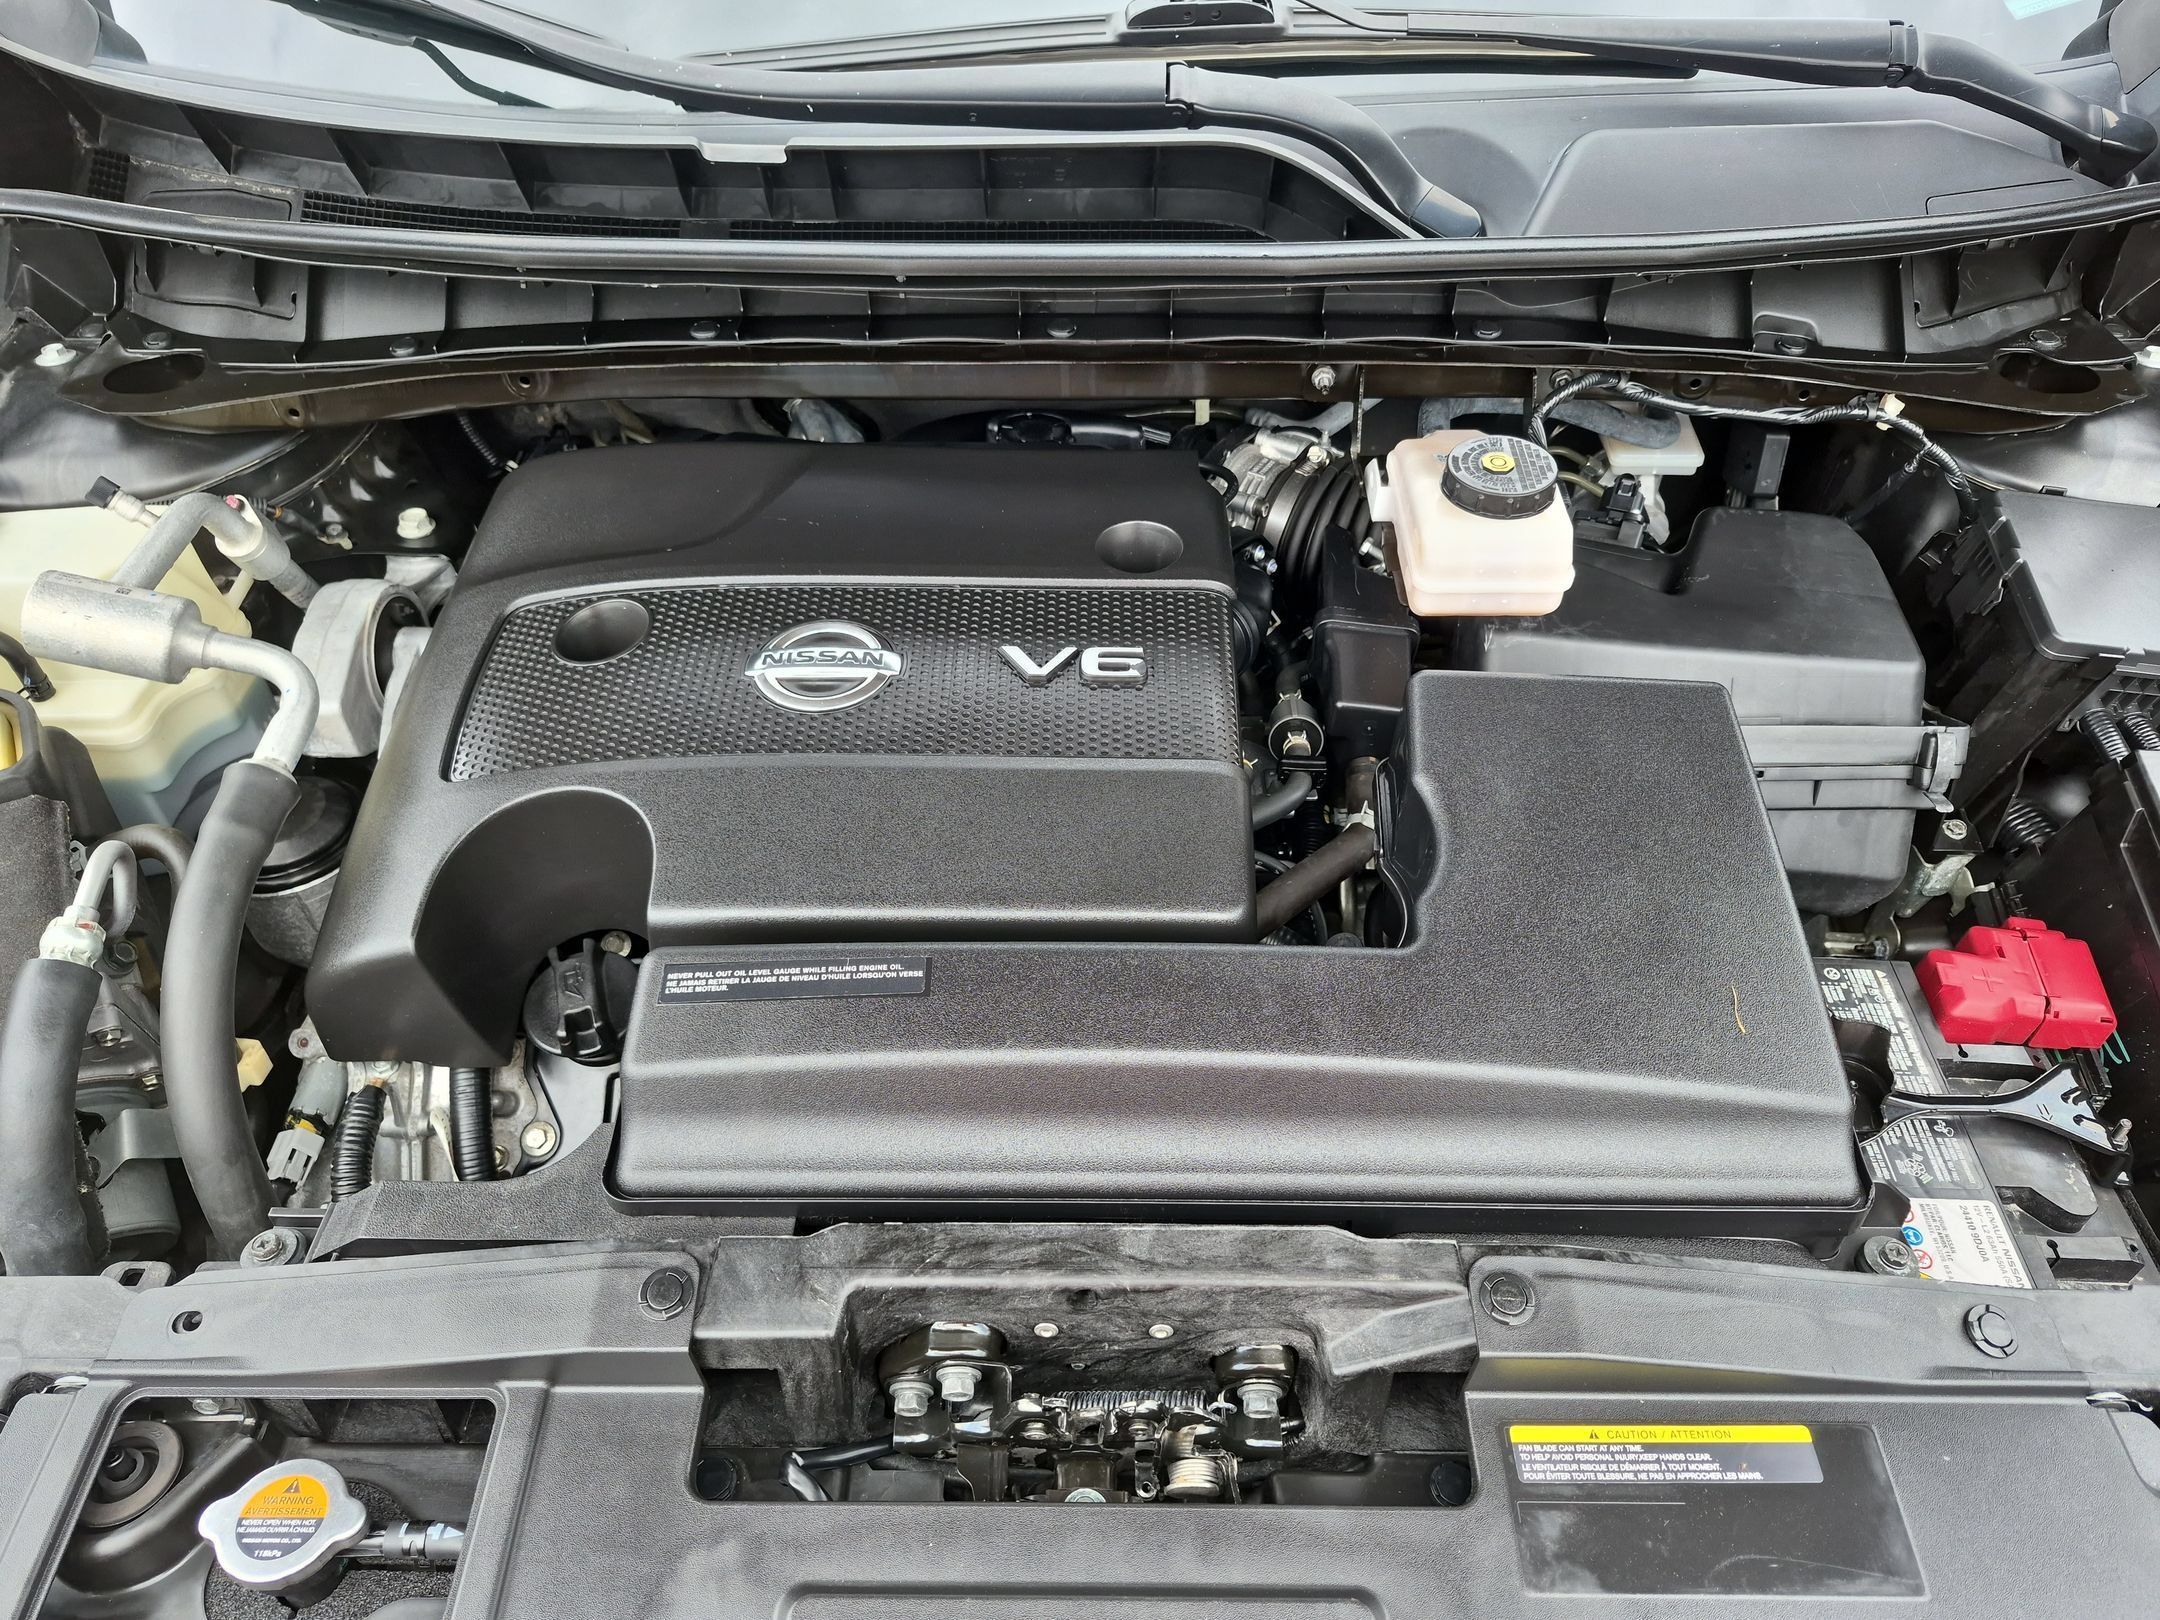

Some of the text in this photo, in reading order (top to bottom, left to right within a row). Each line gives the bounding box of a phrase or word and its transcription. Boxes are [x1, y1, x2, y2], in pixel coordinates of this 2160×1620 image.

[760, 648, 885, 666] NISSAN
[998, 645, 1148, 687] V6
[667, 972, 693, 980] NEVER
[694, 971, 714, 979] PULL
[715, 970, 732, 978] OUT
[734, 969, 747, 977] OIL
[748, 968, 771, 976] LEVEL
[773, 967, 801, 975] GAUGE
[802, 966, 826, 974] WHILE
[828, 965, 857, 973] FILLING
[678, 979, 706, 987] JAMAIS
[752, 976, 777, 984] JAUGE
[791, 974, 819, 982] NIVEAU
[853, 971, 897, 979] LORSQU'ON
[695, 985, 729, 993] MOTEUR.
[1959, 1205, 1977, 1231] 24410
[1983, 1205, 2025, 1289] RENAULT NISSAN
[1607, 1430, 1657, 1439] CAUTION
[1670, 1430, 1732, 1439] ATTENTION
[1522, 1462, 1722, 1471] LE VENTILATEUR RISQUE DE DÉMARRER À TOUT MOMENT.
[1546, 1471, 1571, 1480] ÉVITER
[263, 1496, 314, 1504] WARNING
[246, 1507, 323, 1515] AVERTISSEMENT
